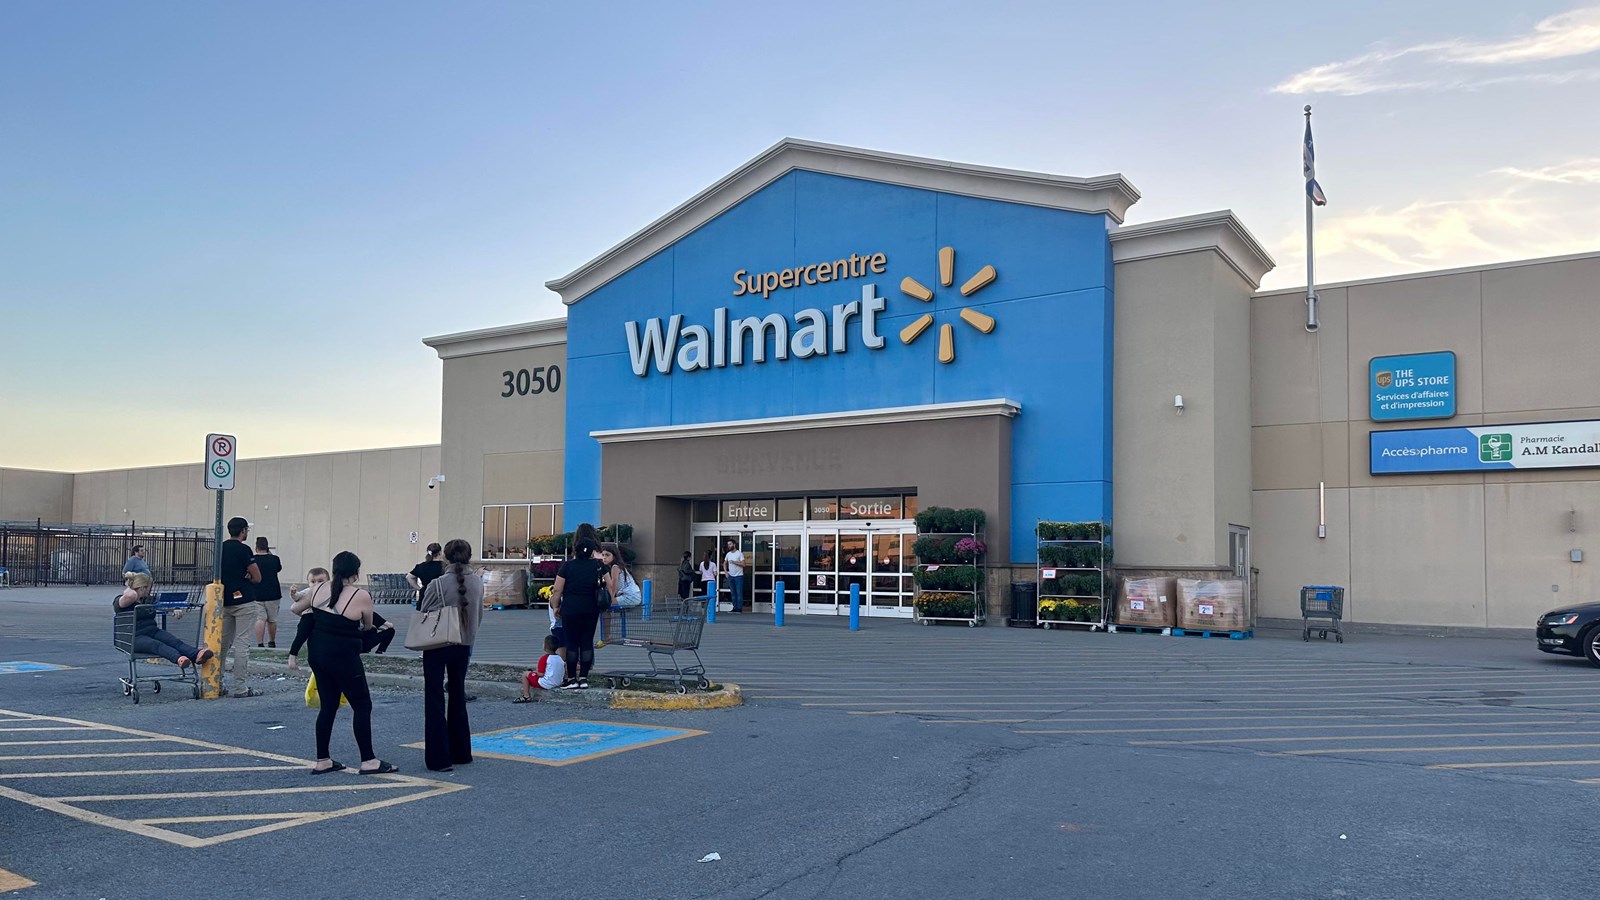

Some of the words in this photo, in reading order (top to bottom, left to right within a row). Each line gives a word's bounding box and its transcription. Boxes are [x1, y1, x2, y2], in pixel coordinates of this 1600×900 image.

[733, 251, 887, 298] Supercentre
[625, 283, 886, 377] Walmart
[1395, 368, 1414, 379] THE
[501, 364, 562, 398] 3050
[1395, 378, 1415, 388] UPS
[1417, 375, 1449, 386] STORE
[1376, 393, 1410, 402] Services
[1411, 390, 1449, 399] d'affaires
[1380, 402, 1390, 410] et
[1390, 400, 1445, 410] d'impression
[1520, 434, 1565, 444] Pharmacie
[1521, 445, 1548, 456] A.M
[728, 504, 768, 518] Entrée
[814, 506, 830, 514] 3050
[850, 501, 892, 515] Sortie
